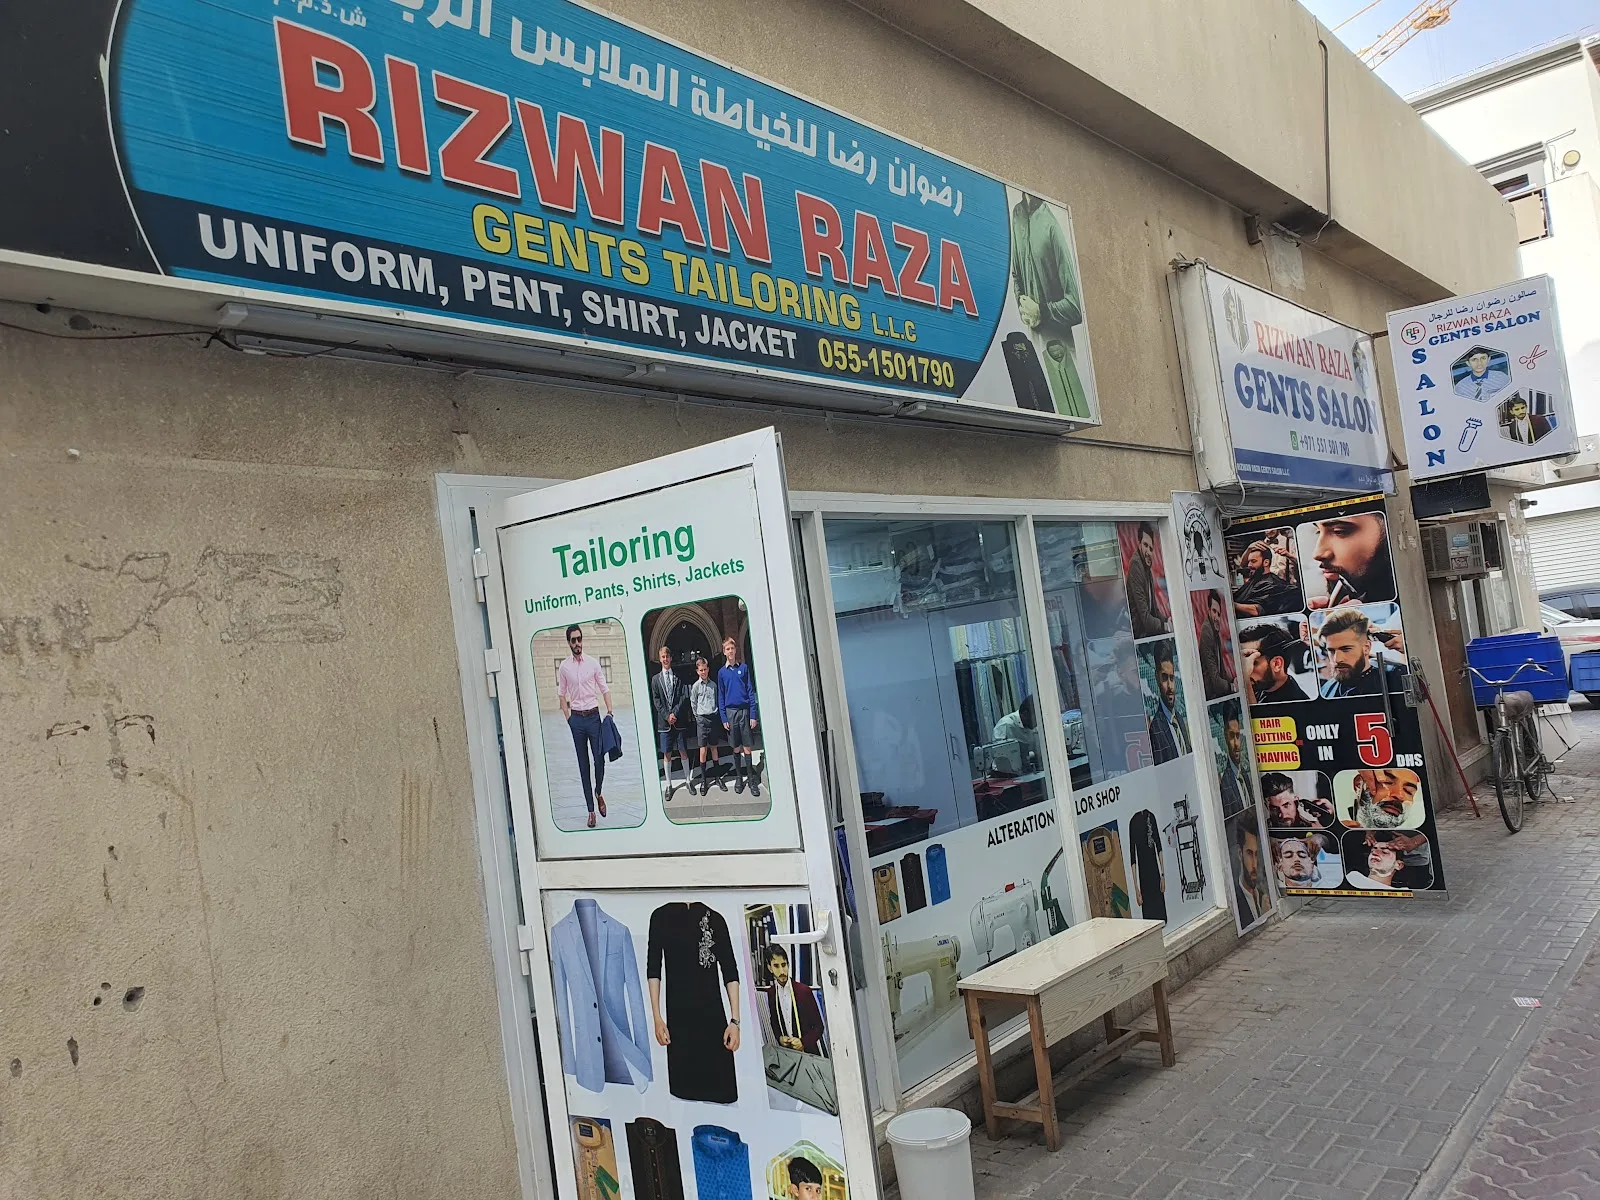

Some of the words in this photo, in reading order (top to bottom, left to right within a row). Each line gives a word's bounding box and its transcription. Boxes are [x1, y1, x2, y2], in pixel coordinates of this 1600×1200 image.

[510, 16, 679, 108] الملابس
[690, 74, 817, 158] للخياطة
[272, 16, 772, 264] RIZWAN
[795, 190, 979, 319] RAZA
[828, 131, 877, 185] رضا
[888, 156, 963, 217] رضوان
[471, 203, 651, 287] GENTS
[662, 249, 862, 330] TAILORING
[872, 311, 916, 343] L.L.C
[1508, 289, 1537, 303] صالون
[198, 213, 449, 306] UNIFORM,
[462, 266, 573, 328] PENT,
[583, 290, 687, 349] SHIRT,
[695, 313, 798, 360] JACKET
[818, 337, 956, 389] 055-1501790
[1428, 309, 1453, 323] للرجال
[1428, 325, 1481, 346] GENTS
[1484, 310, 1541, 332] SALON
[1436, 315, 1479, 333] RIZWAN
[1481, 307, 1512, 321] RAZA
[1455, 305, 1474, 314] رضا
[1476, 296, 1506, 311] رضوان
[1253, 320, 1317, 371] RIZWAN
[1316, 343, 1353, 381] RAZA
[1234, 362, 1315, 422] GENTS
[1317, 385, 1380, 435] SALON
[1411, 348, 1446, 467] SALON
[552, 523, 696, 579] Tailoring
[524, 588, 582, 615] Uniform,
[585, 580, 630, 604] Pants,
[633, 572, 682, 595] Shirts,
[685, 556, 745, 585] Jackets
[1254, 731, 1292, 743] CUTTING
[1259, 719, 1281, 729] HAIR
[1305, 724, 1340, 740] ONLY
[1353, 712, 1393, 767] 5
[1317, 746, 1334, 761] IN
[1396, 753, 1424, 768] DHS
[987, 809, 1056, 848] ALTERATION
[1074, 795, 1095, 816] LOR
[1097, 785, 1121, 809] SHOP
